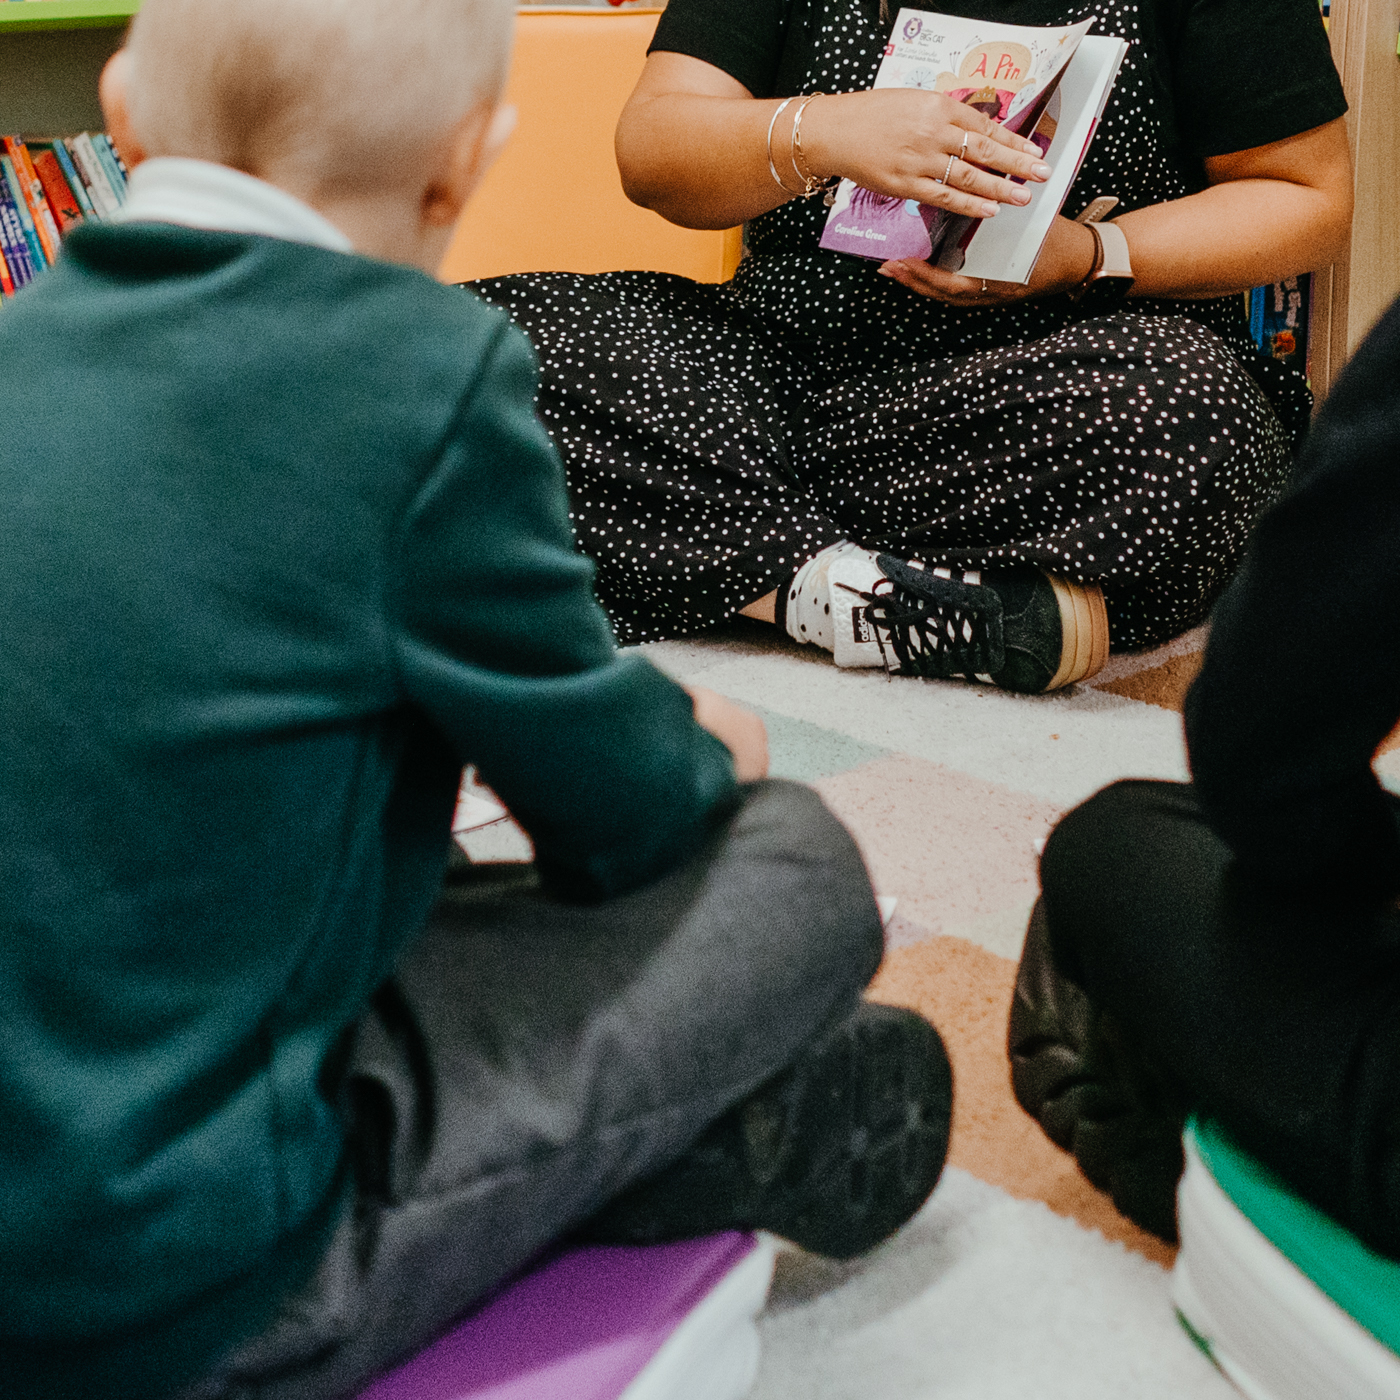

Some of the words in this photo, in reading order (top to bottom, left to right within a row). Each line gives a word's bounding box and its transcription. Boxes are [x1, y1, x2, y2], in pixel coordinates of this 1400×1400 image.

[920, 33, 932, 41] BIG
[932, 36, 946, 44] CAT
[969, 52, 987, 78] A
[993, 53, 1021, 80] Pin
[835, 223, 864, 237] Caroline
[865, 229, 887, 241] Green
